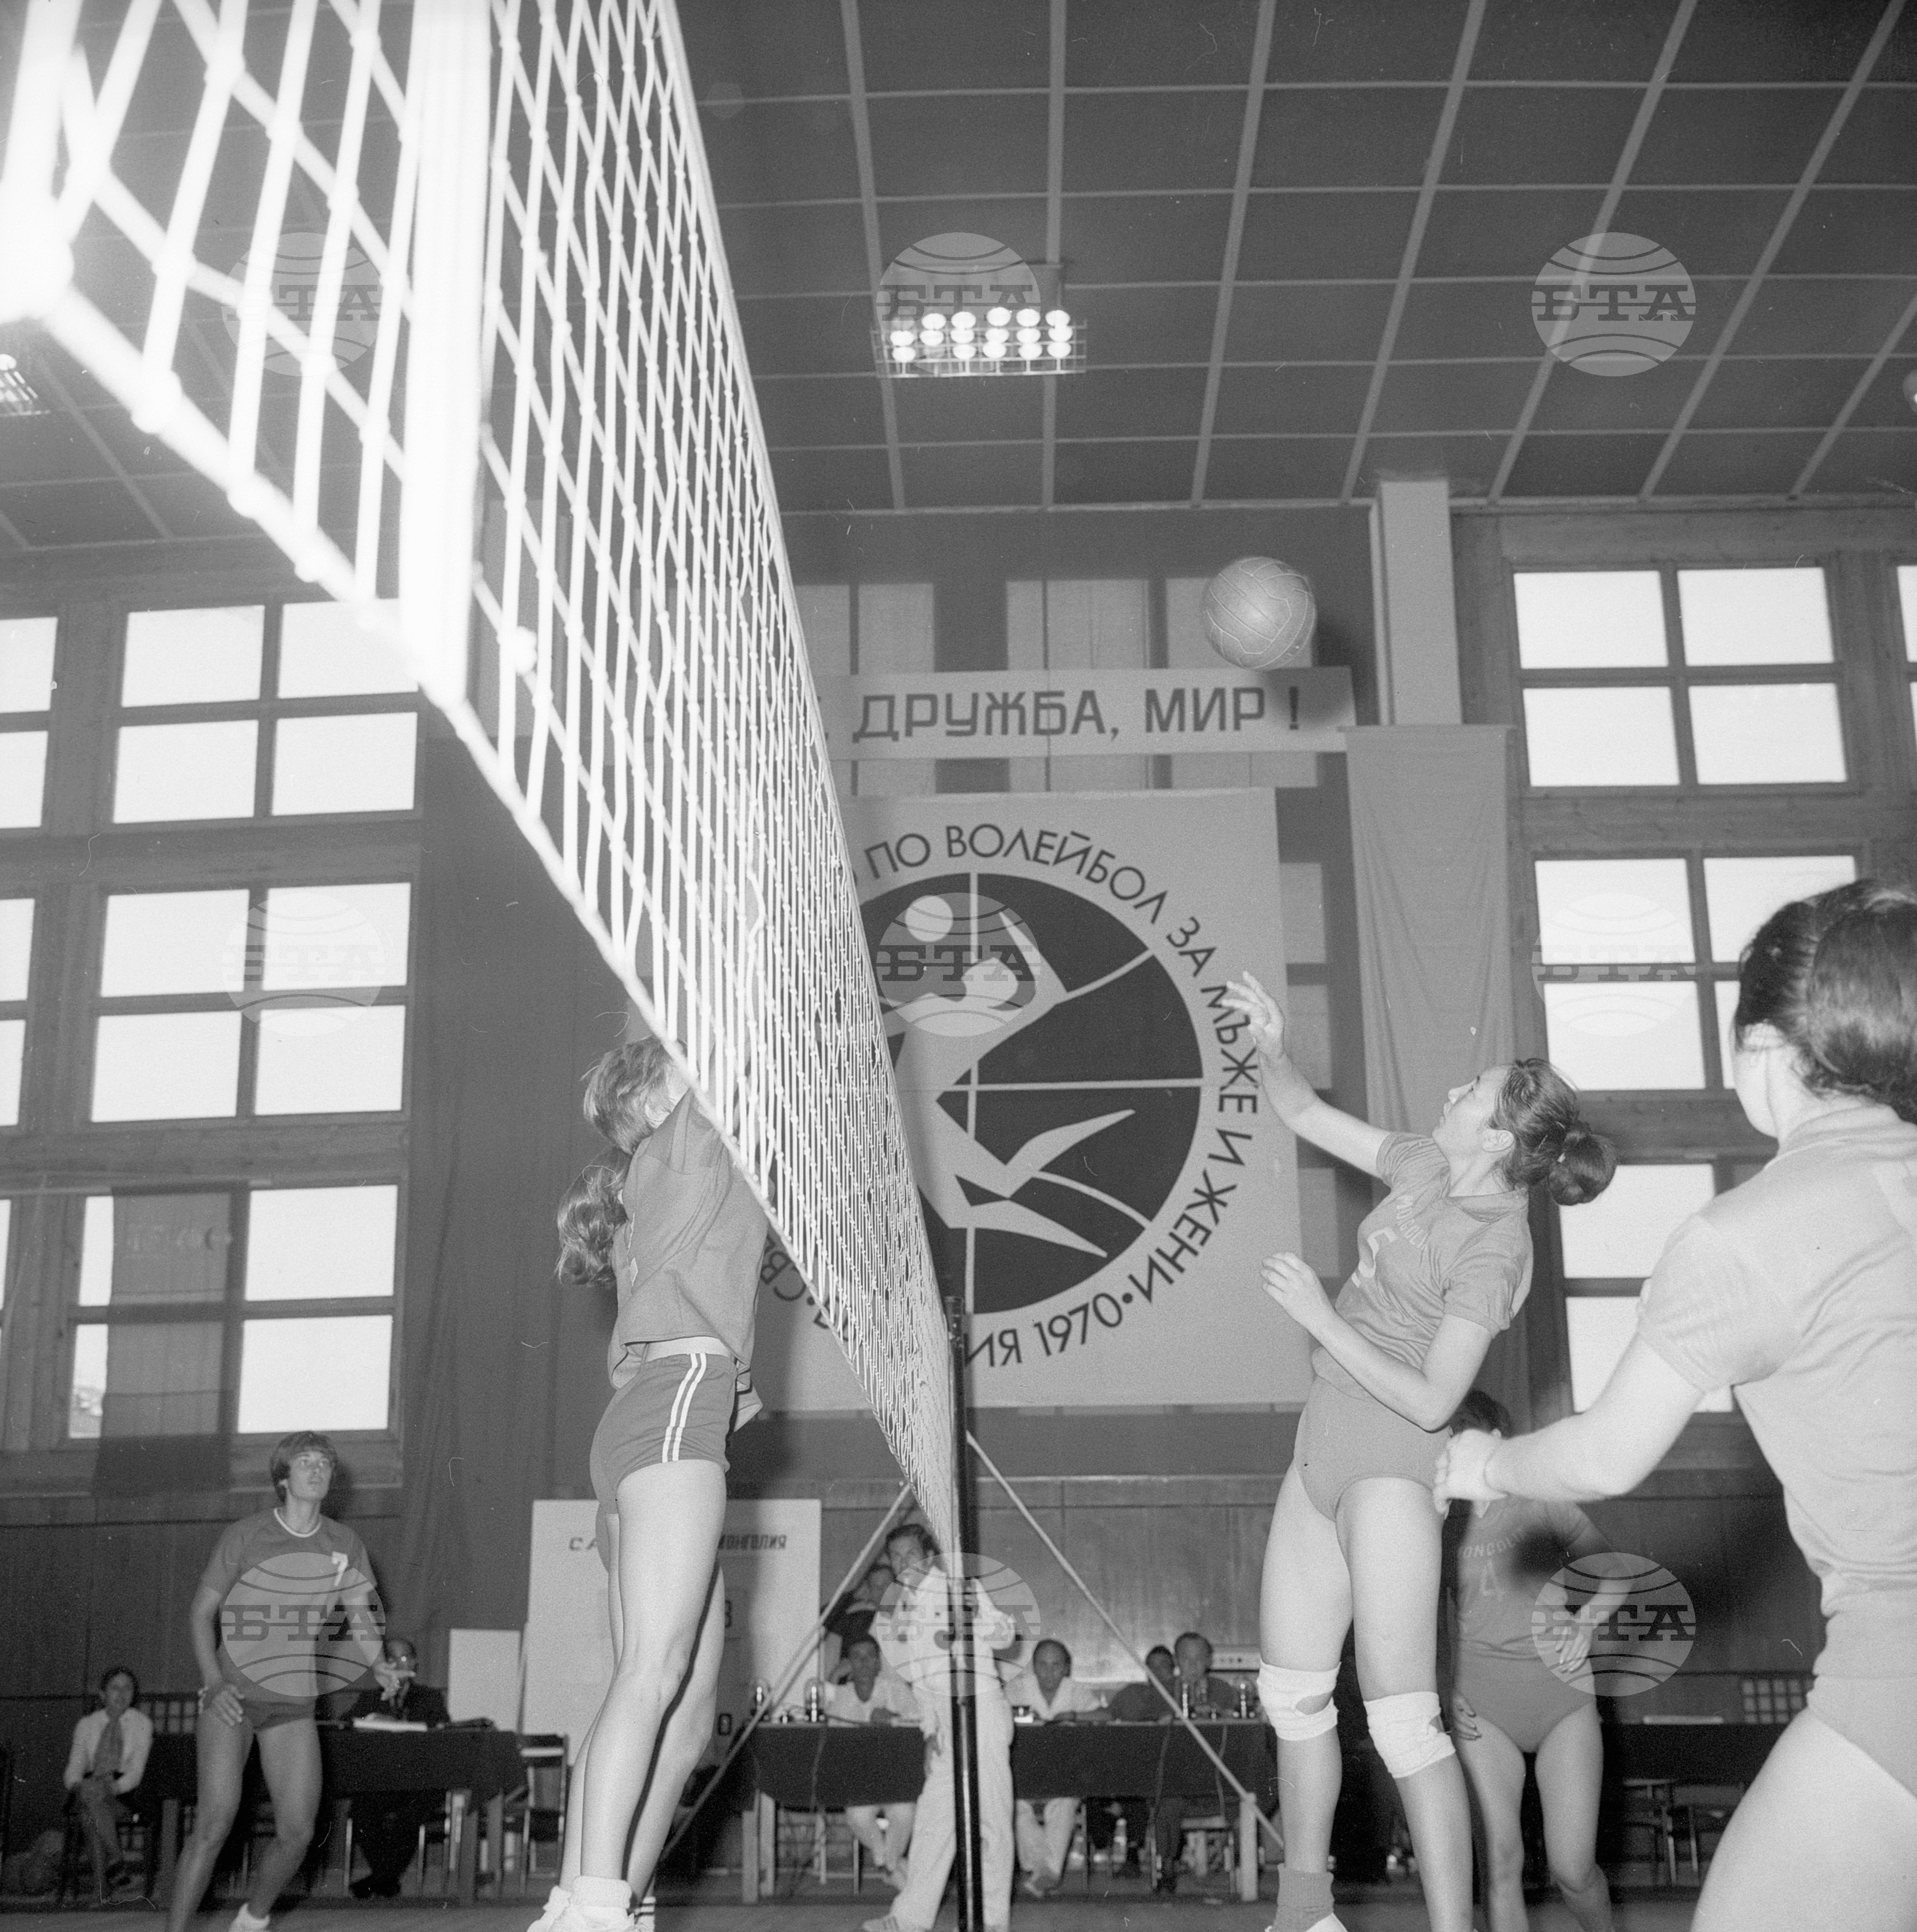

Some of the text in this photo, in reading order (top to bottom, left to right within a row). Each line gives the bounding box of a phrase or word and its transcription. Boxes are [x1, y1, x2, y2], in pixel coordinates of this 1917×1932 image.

[852, 689, 1119, 744] ДРУЖБА,
[864, 823, 1259, 1304] ПО ВОЛЕЙБОЛ ЗА МЪЖЕ И ЖЕНИ
[1396, 1194, 1430, 1250] MOGOLI
[1033, 1293, 1123, 1357] 1970
[332, 1551, 349, 1587] 7
